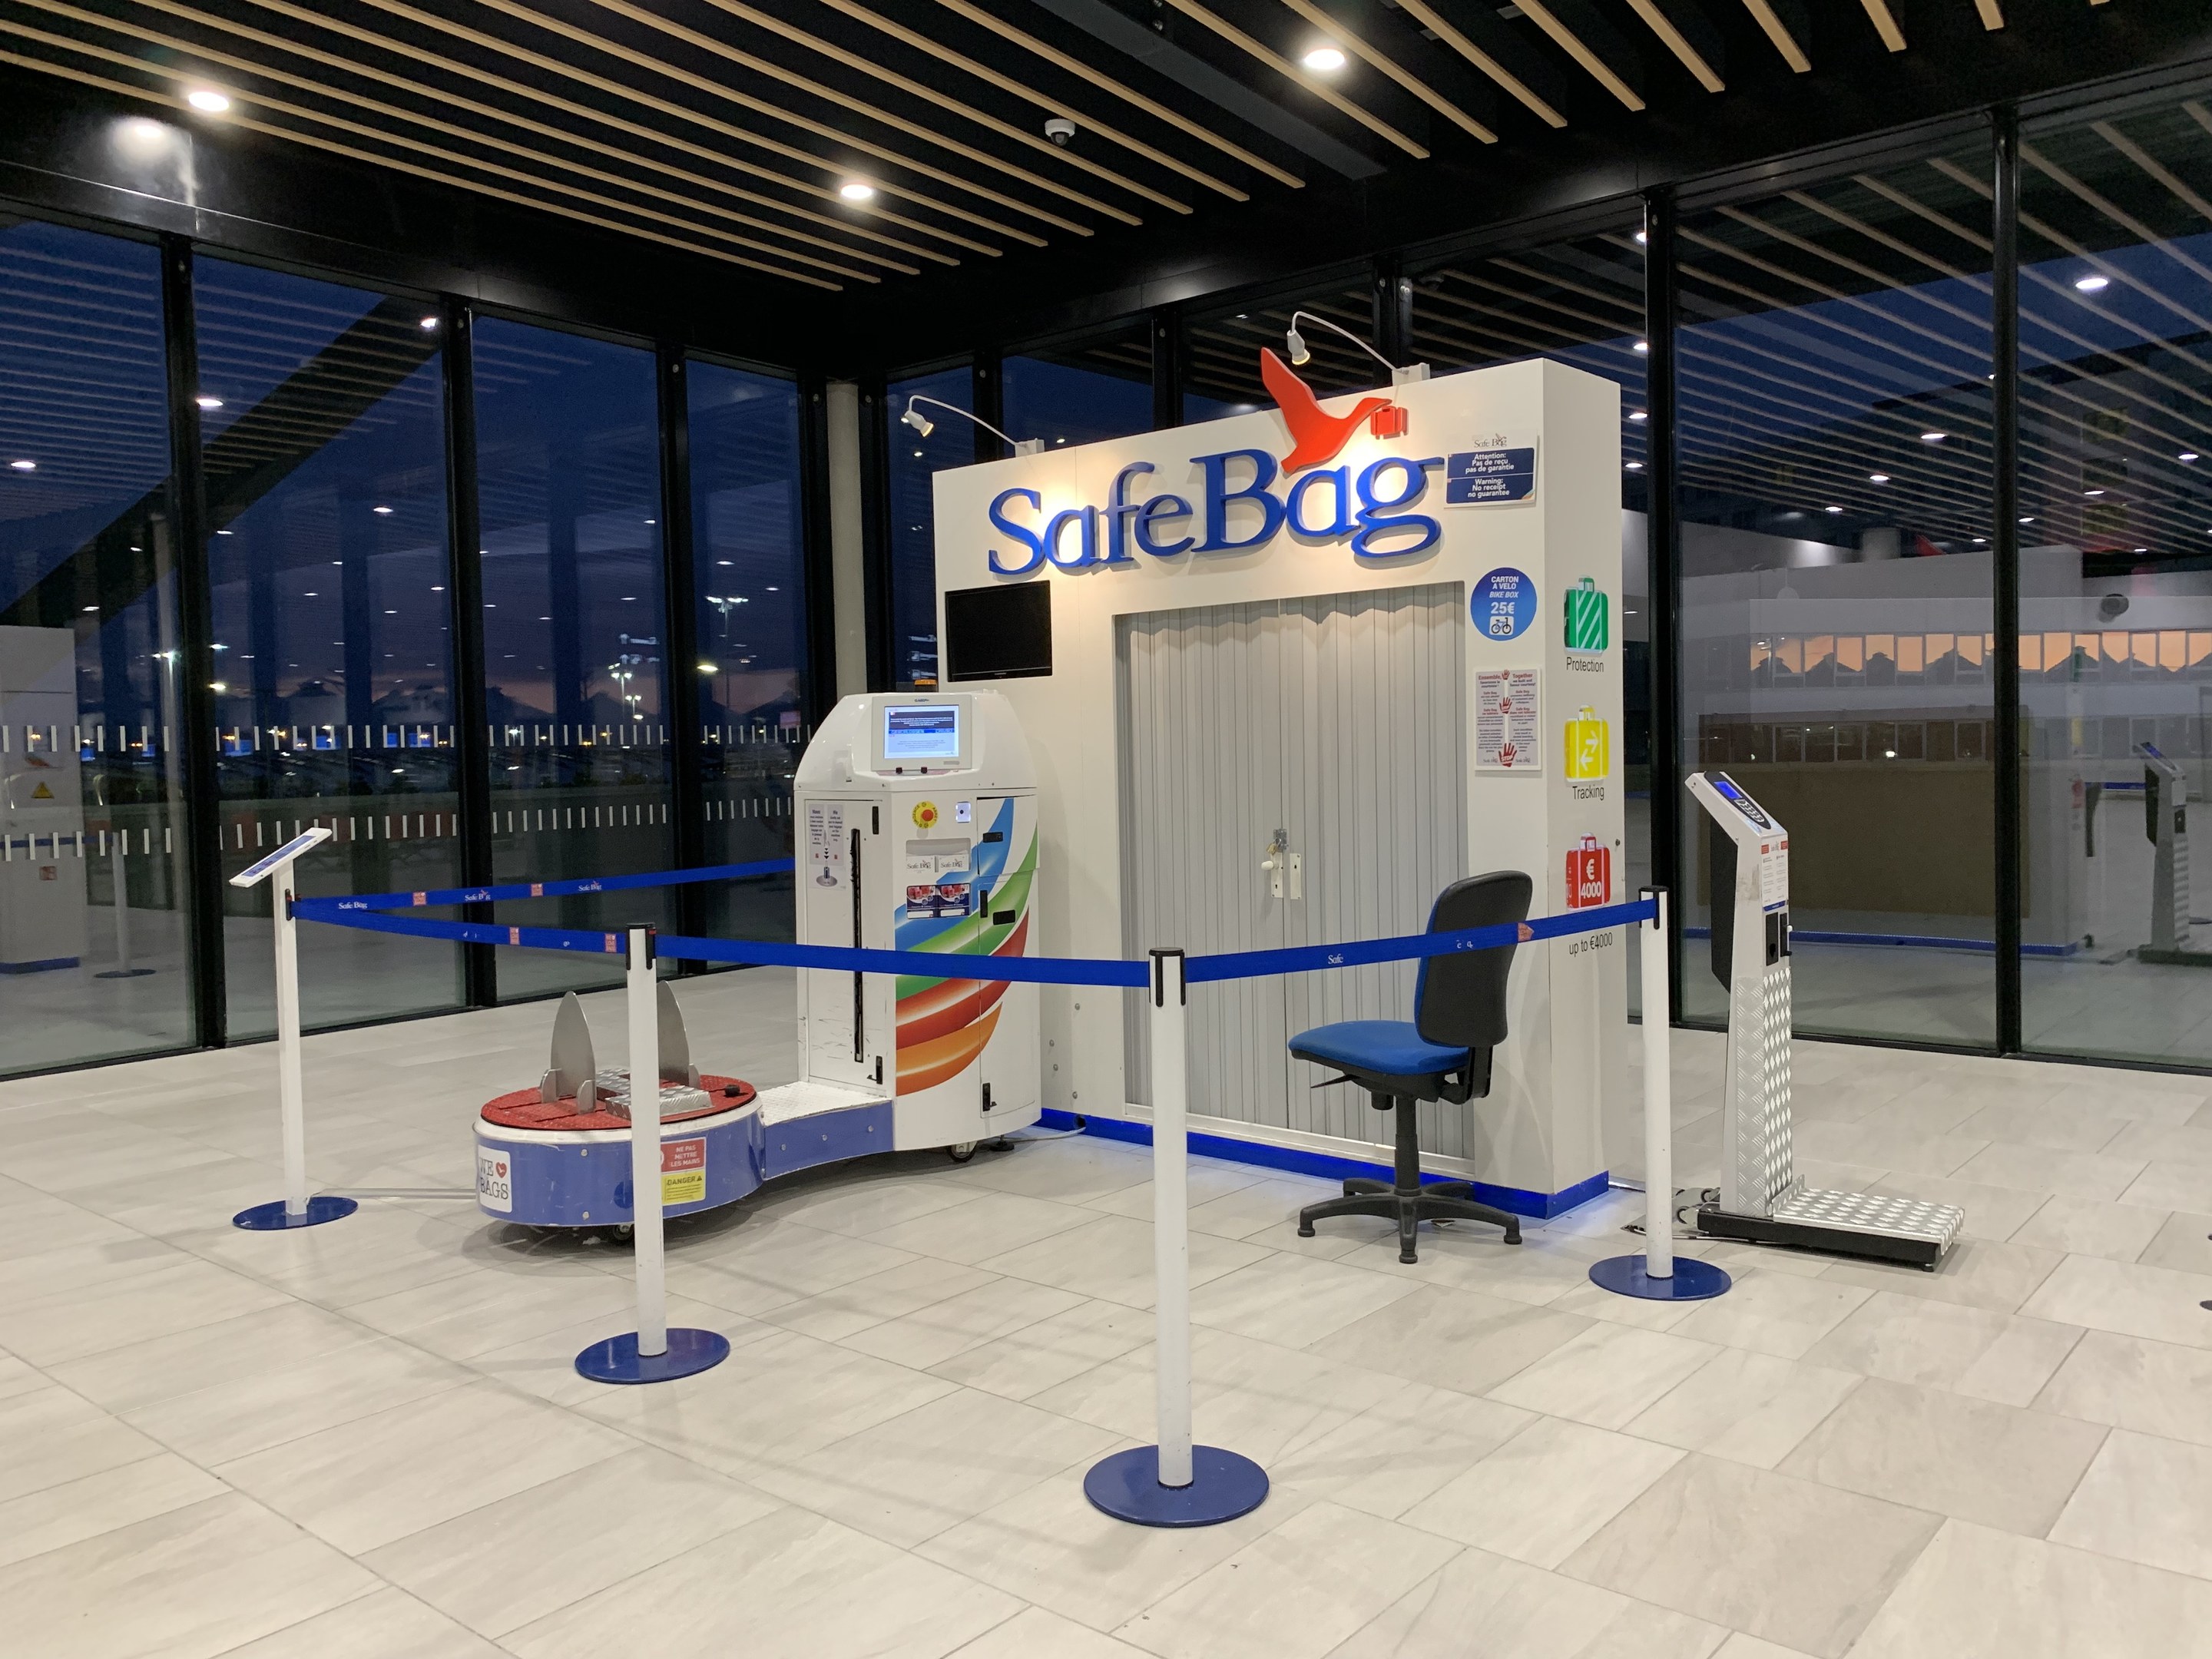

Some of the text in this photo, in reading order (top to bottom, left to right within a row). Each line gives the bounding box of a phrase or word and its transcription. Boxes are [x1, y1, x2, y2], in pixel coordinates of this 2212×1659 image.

[1474, 439, 1490, 448] Safe
[1488, 463, 1515, 473] garantie
[1477, 490, 1510, 499] guarantee
[1490, 601, 1515, 614] 25€
[1566, 656, 1604, 673] Protection
[1572, 784, 1604, 800] Tracking
[1586, 858, 1595, 880] €
[1581, 881, 1602, 899] 4000
[354, 901, 368, 909] Bag
[1569, 932, 1613, 957] up to €4000
[674, 1151, 697, 1160] METTRE
[682, 1157, 700, 1166] MAINS
[479, 1157, 494, 1177] WE
[667, 1175, 696, 1186] DANGER
[480, 1177, 508, 1200] BAGS
